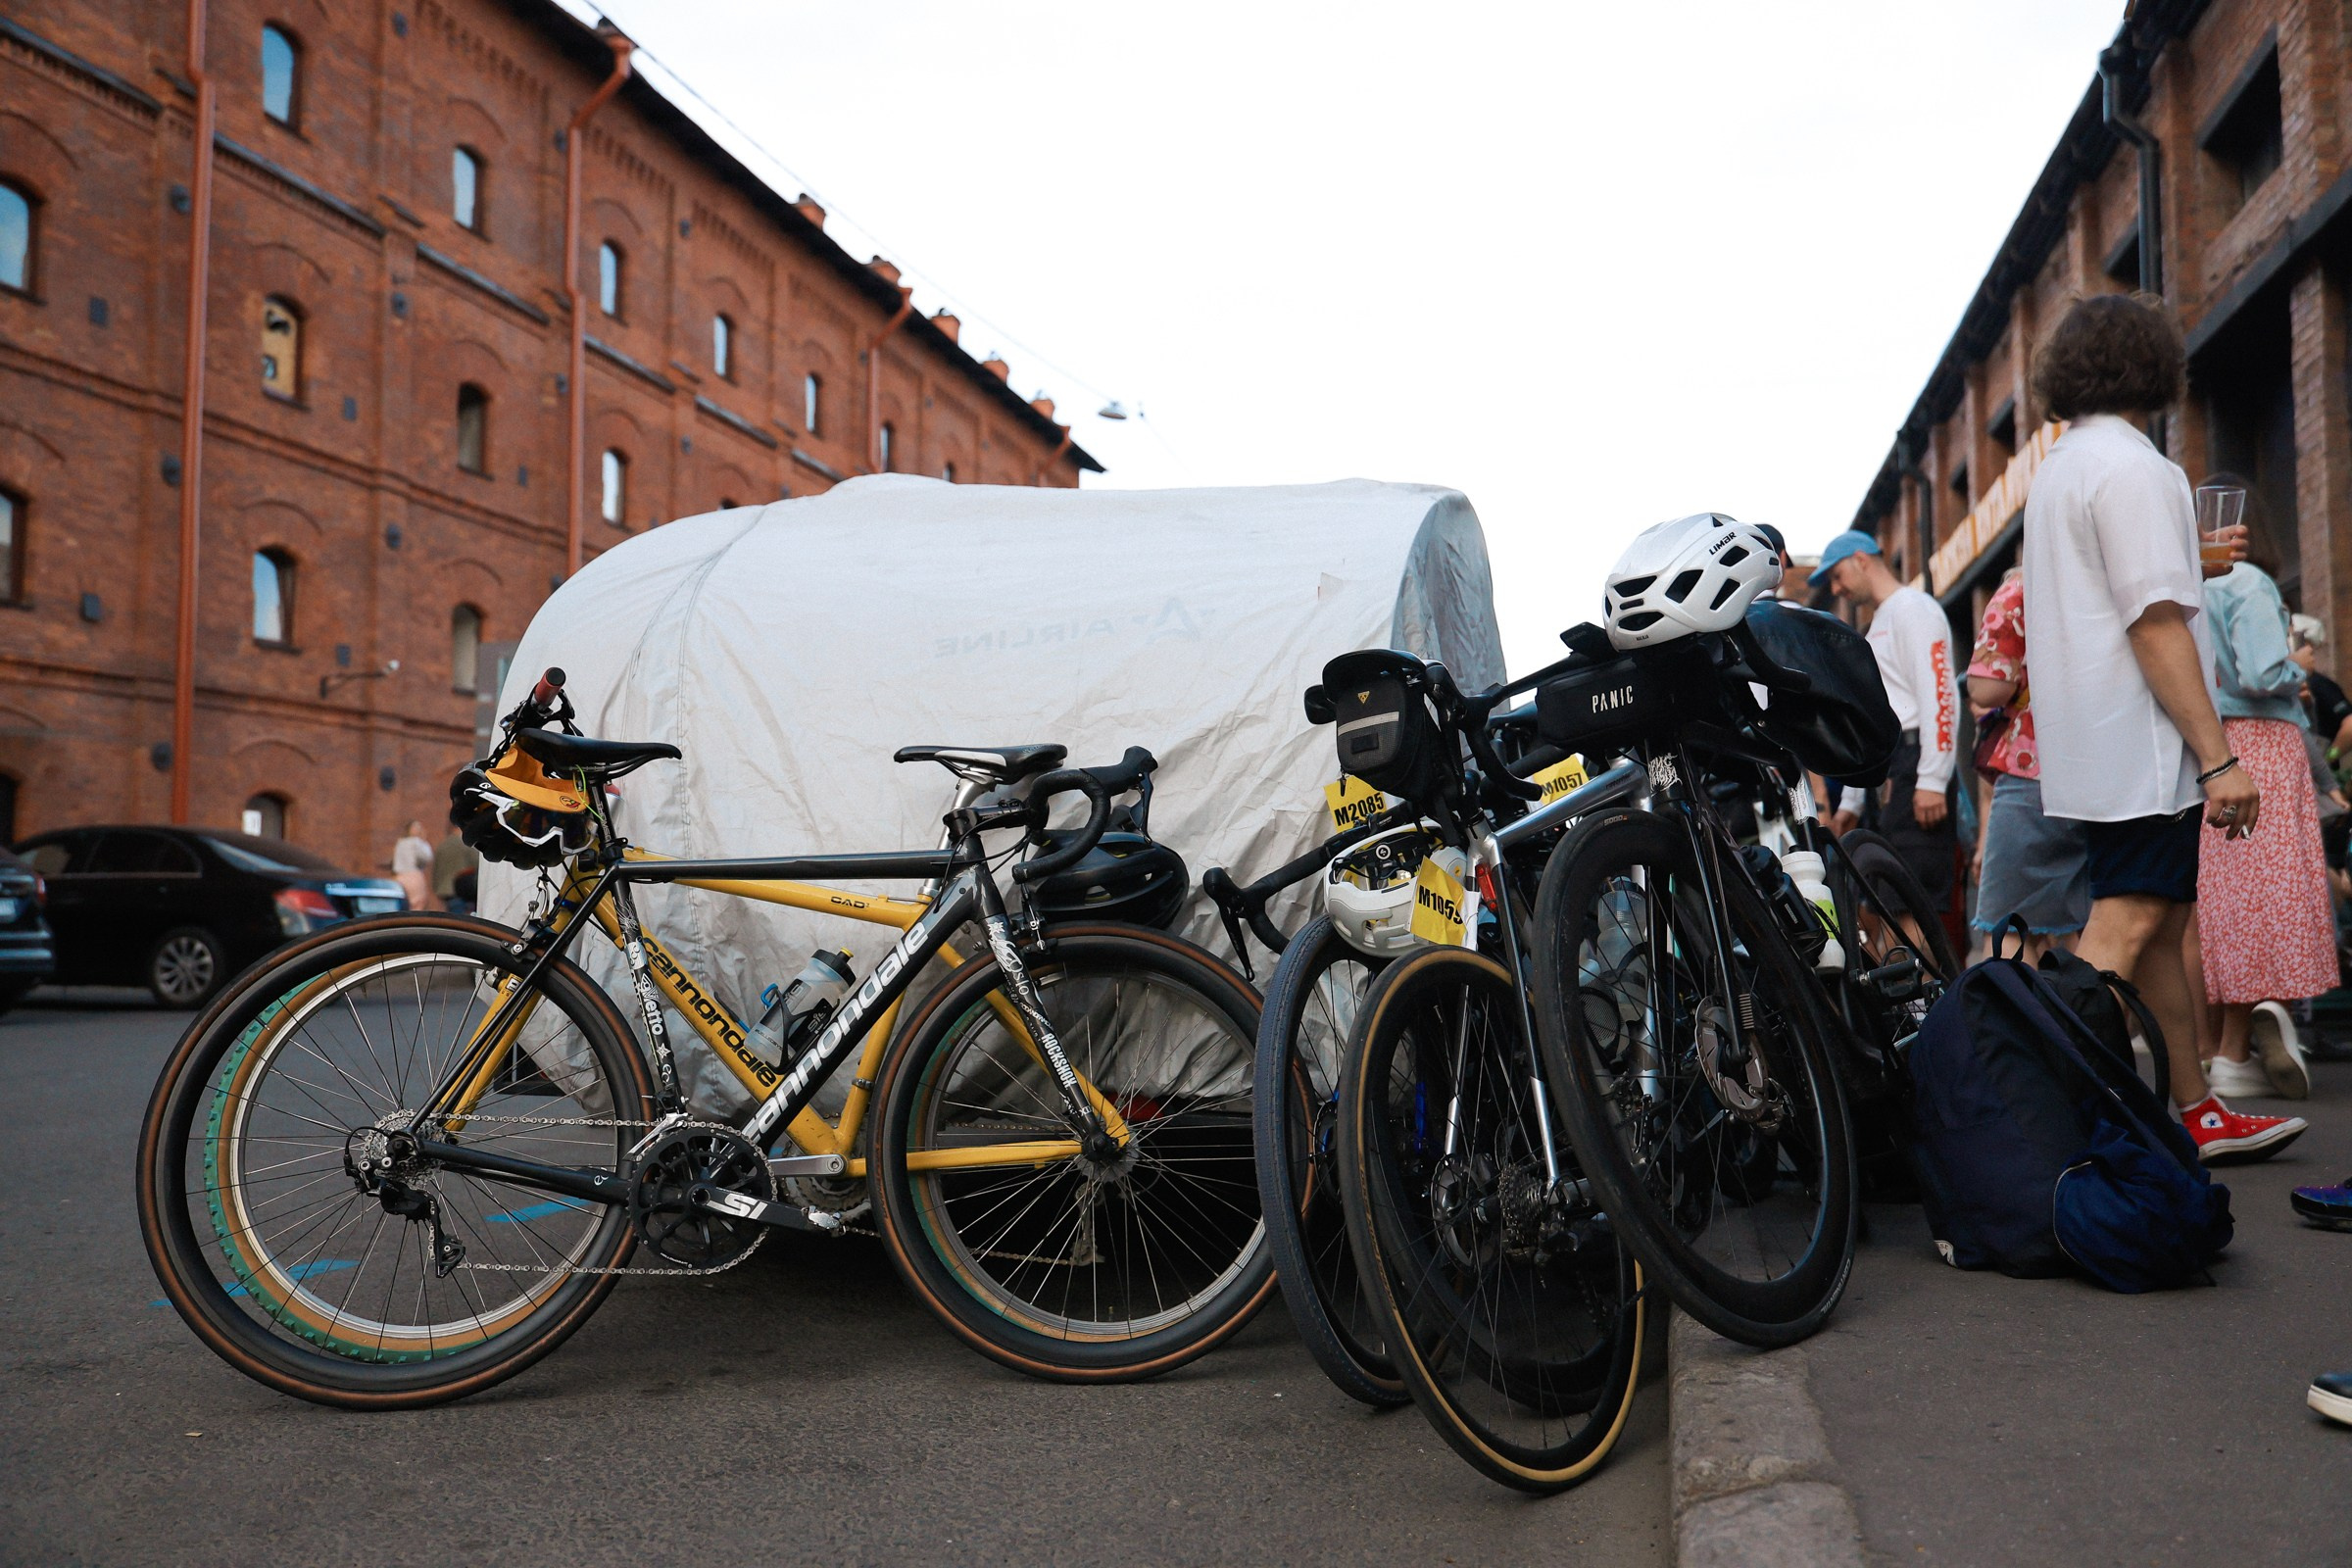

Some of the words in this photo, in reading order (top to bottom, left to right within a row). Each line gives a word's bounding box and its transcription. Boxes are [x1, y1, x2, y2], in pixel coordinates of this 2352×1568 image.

[1592, 685, 1635, 714] PANIC
[1541, 771, 1584, 797] M1057
[1333, 792, 1385, 827] M2085
[742, 921, 929, 1145] cannondale
